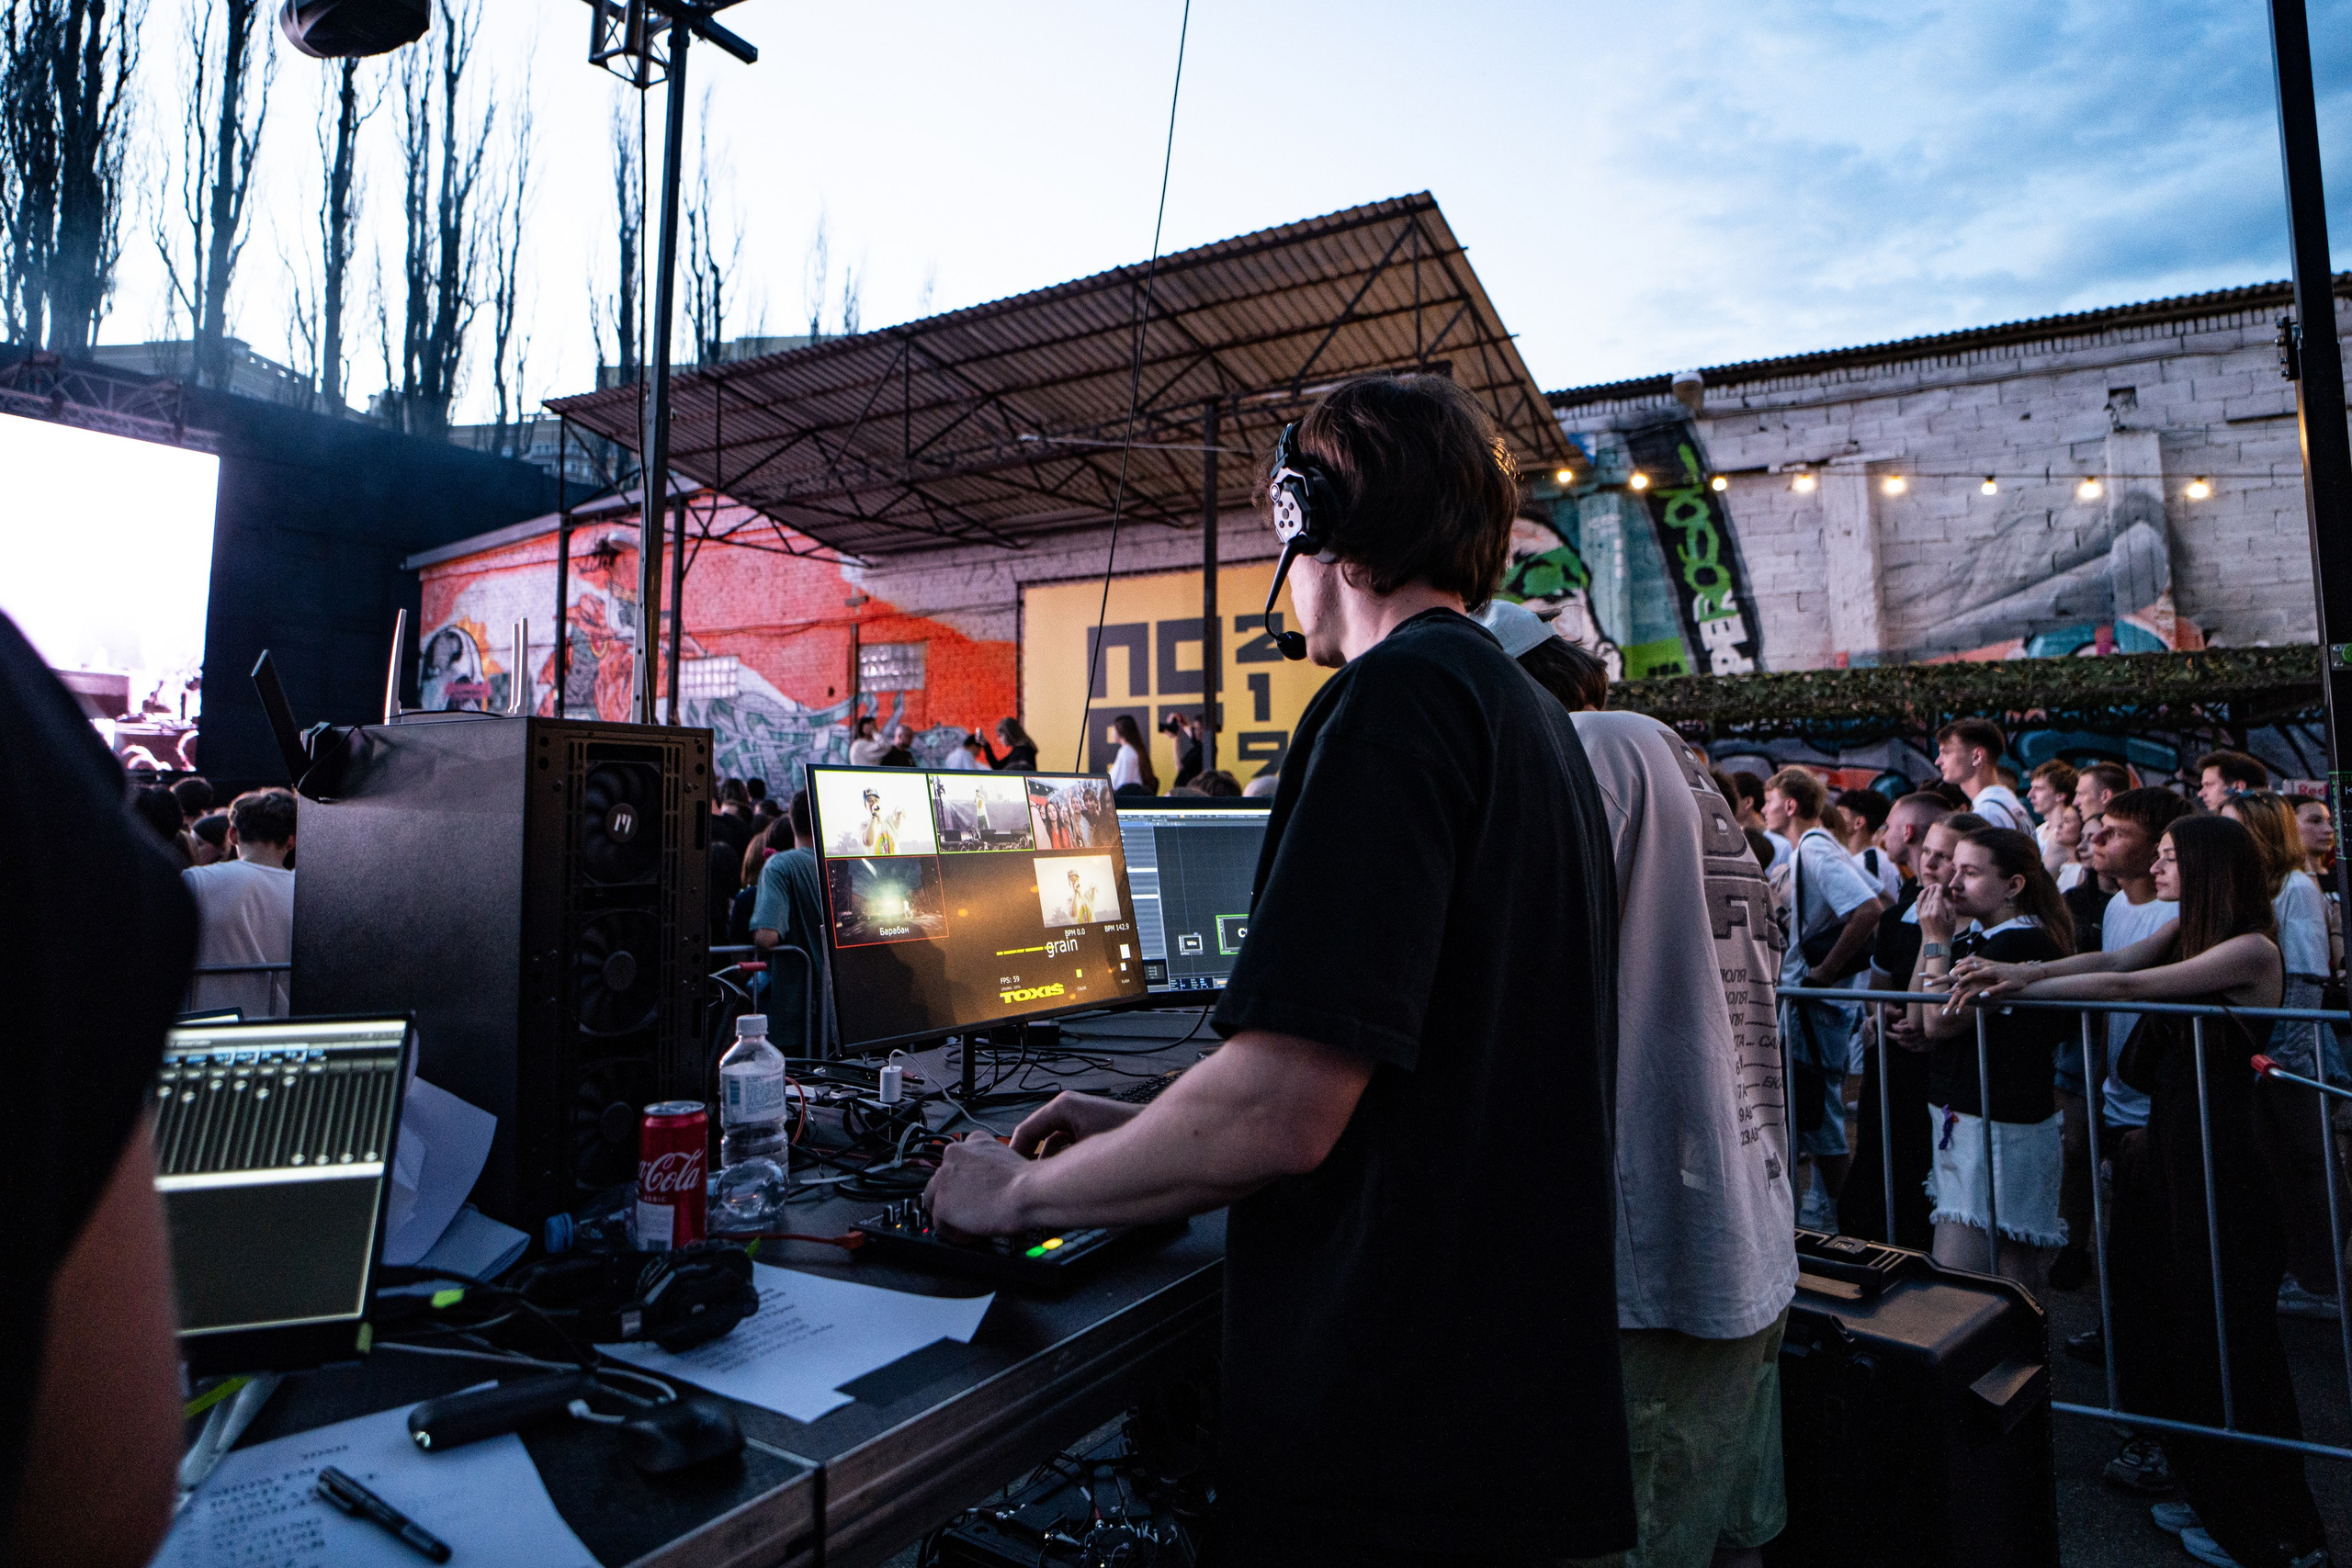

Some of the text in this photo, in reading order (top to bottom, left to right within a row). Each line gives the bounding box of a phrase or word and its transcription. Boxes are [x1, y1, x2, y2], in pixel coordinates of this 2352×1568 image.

[879, 926, 910, 937] Барабан
[1064, 928, 1086, 937] BPM 0.0
[1103, 924, 1115, 932] BPM
[1046, 936, 1079, 958] grain
[1012, 975, 1020, 983] 59
